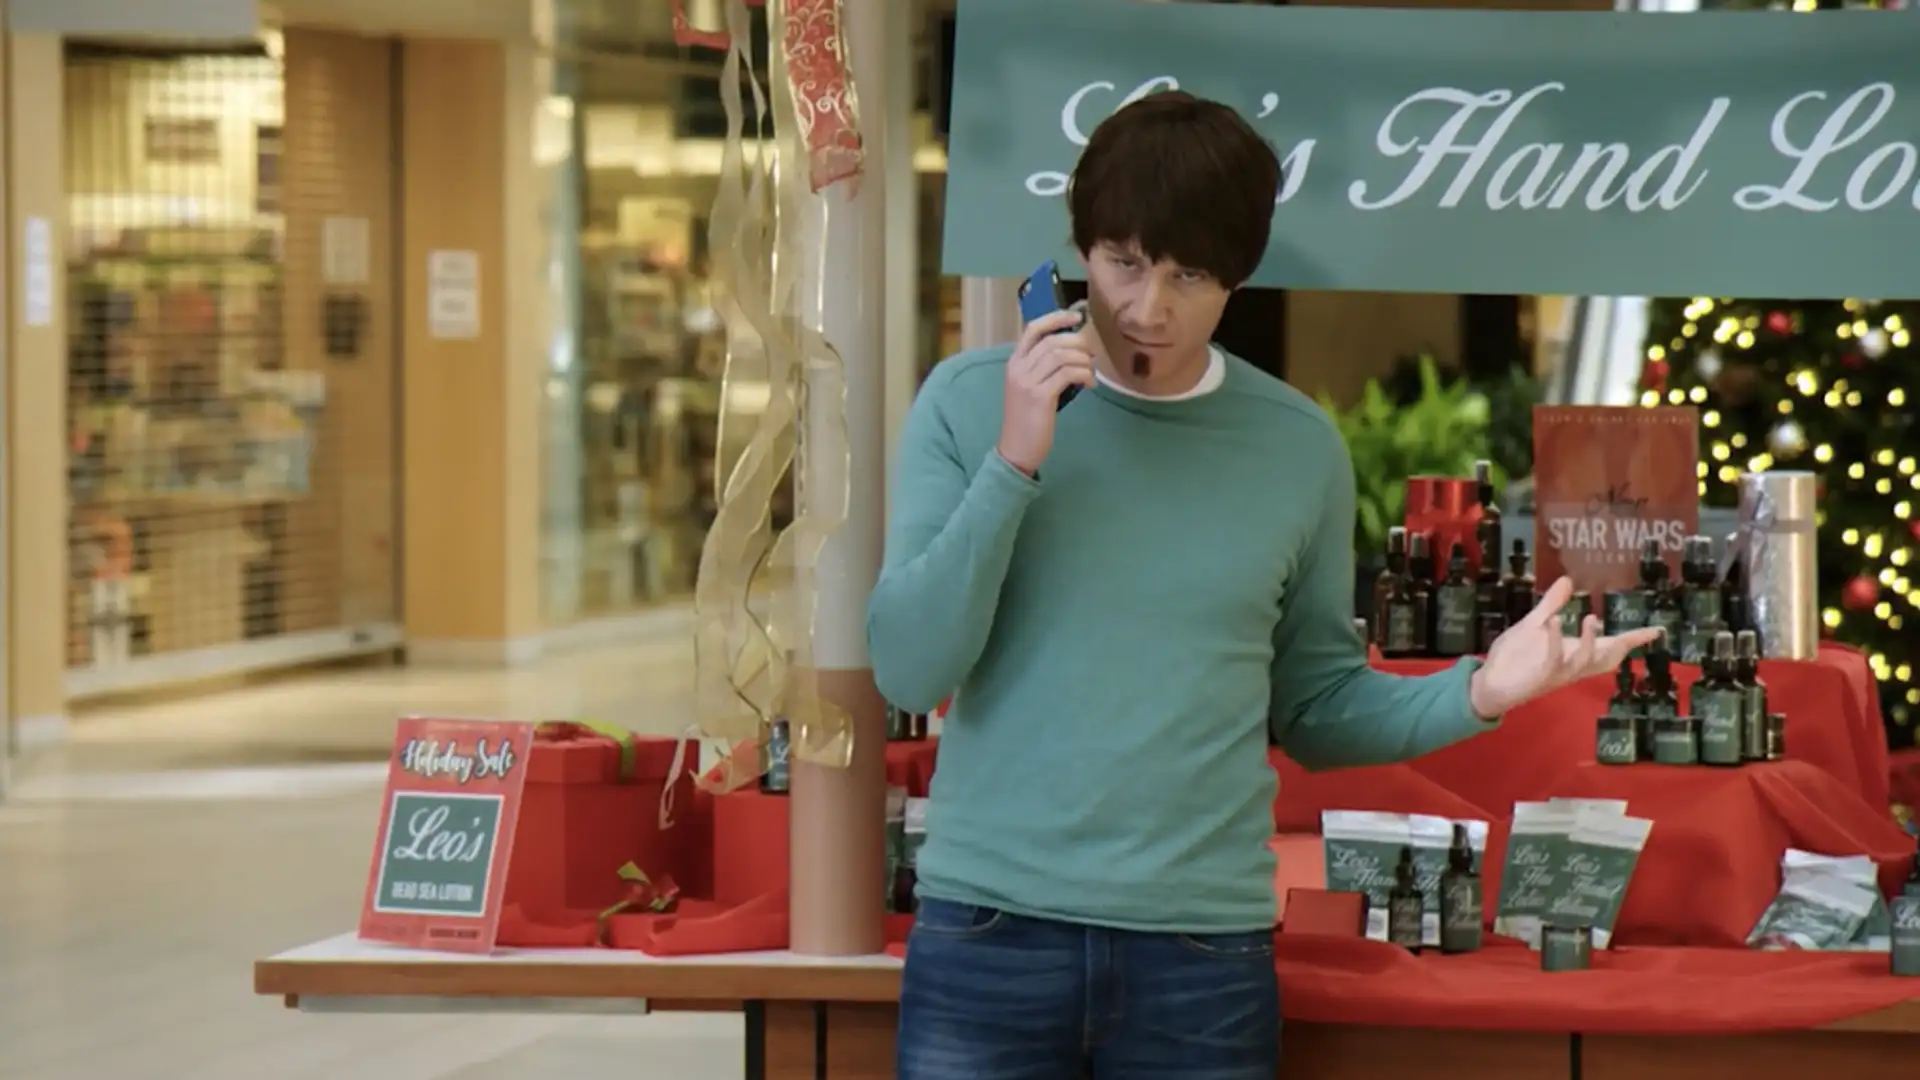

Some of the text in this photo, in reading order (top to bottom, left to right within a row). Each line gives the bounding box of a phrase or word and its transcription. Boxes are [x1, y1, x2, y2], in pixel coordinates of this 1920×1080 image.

[1024, 75, 1920, 212] L's Hand Lo
[1549, 517, 1686, 551] STAR WARS
[402, 737, 514, 784] Holiday Sale
[393, 805, 486, 863] Leo's
[418, 882, 437, 901] SEA
[1352, 867, 1398, 888] Han
